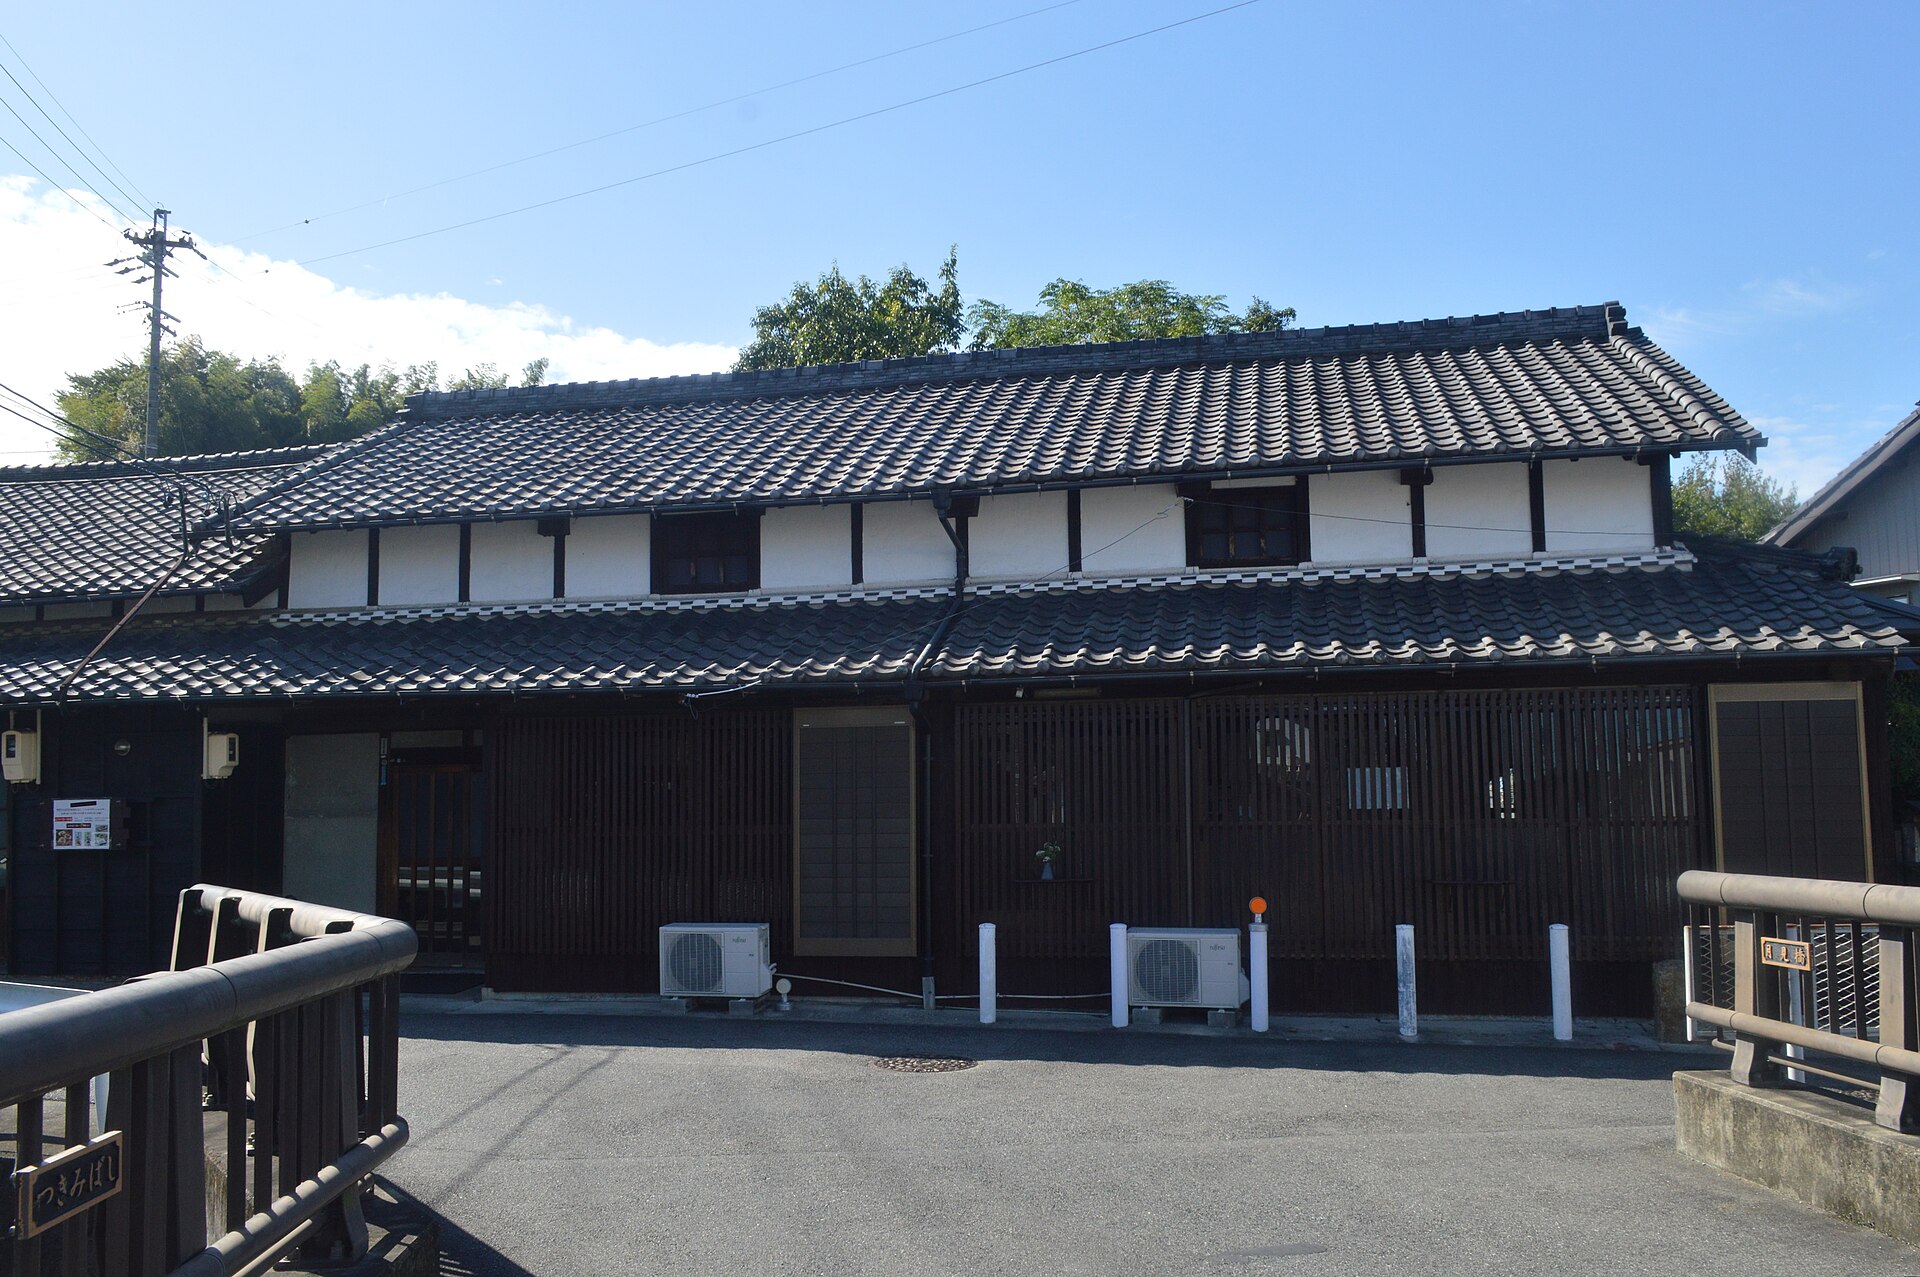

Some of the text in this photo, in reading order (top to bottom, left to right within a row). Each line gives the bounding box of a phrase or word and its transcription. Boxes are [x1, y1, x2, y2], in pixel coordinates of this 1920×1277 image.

[1765, 944, 1806, 967] 月見橋
[37, 1155, 116, 1207] つきみばし
